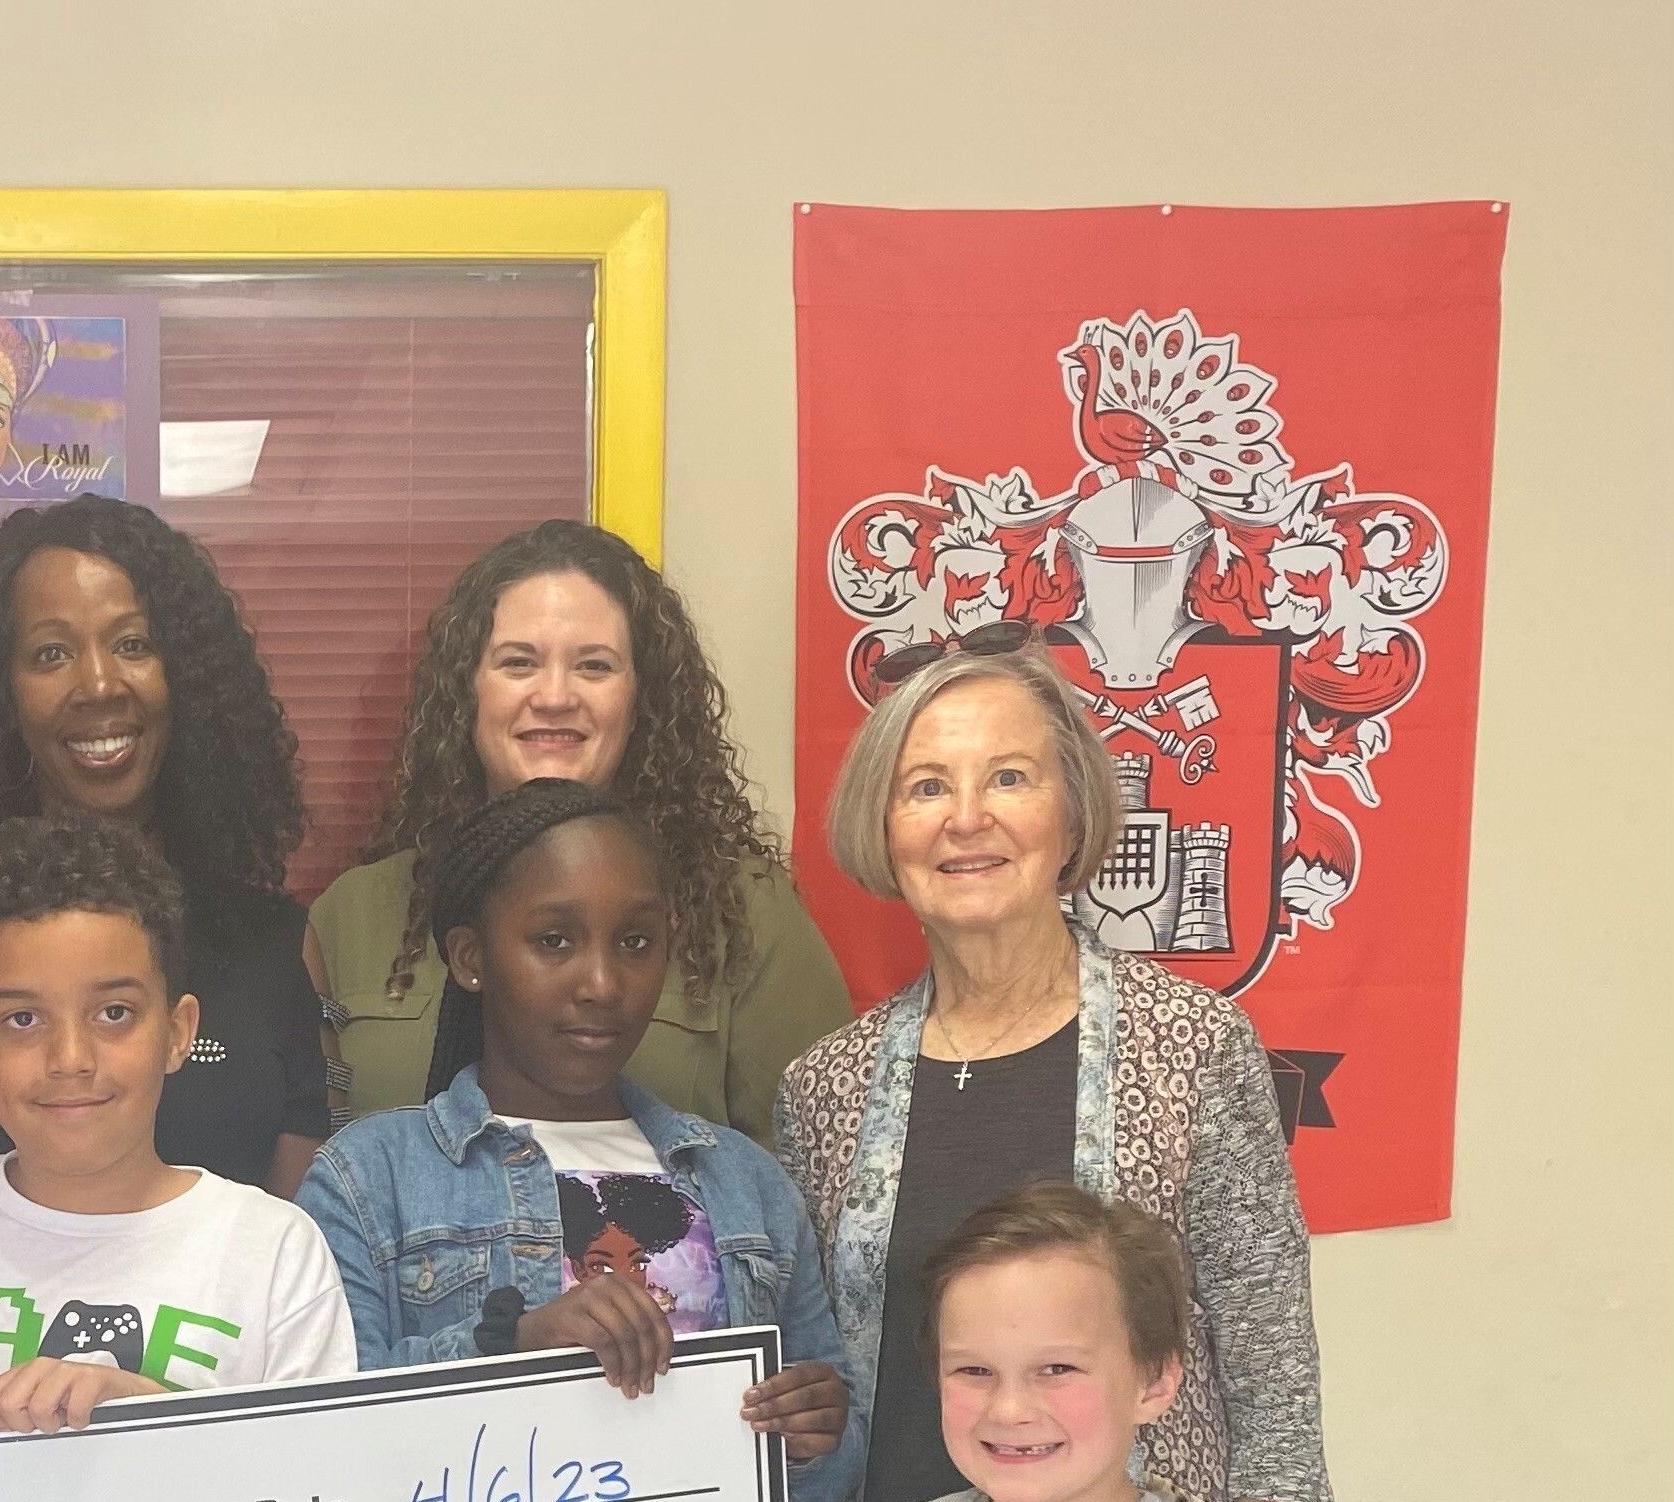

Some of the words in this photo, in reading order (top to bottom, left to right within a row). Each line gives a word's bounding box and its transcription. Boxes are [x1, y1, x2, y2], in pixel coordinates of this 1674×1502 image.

[41, 443, 50, 465] I
[56, 443, 90, 465] AM
[24, 455, 115, 492] Royal
